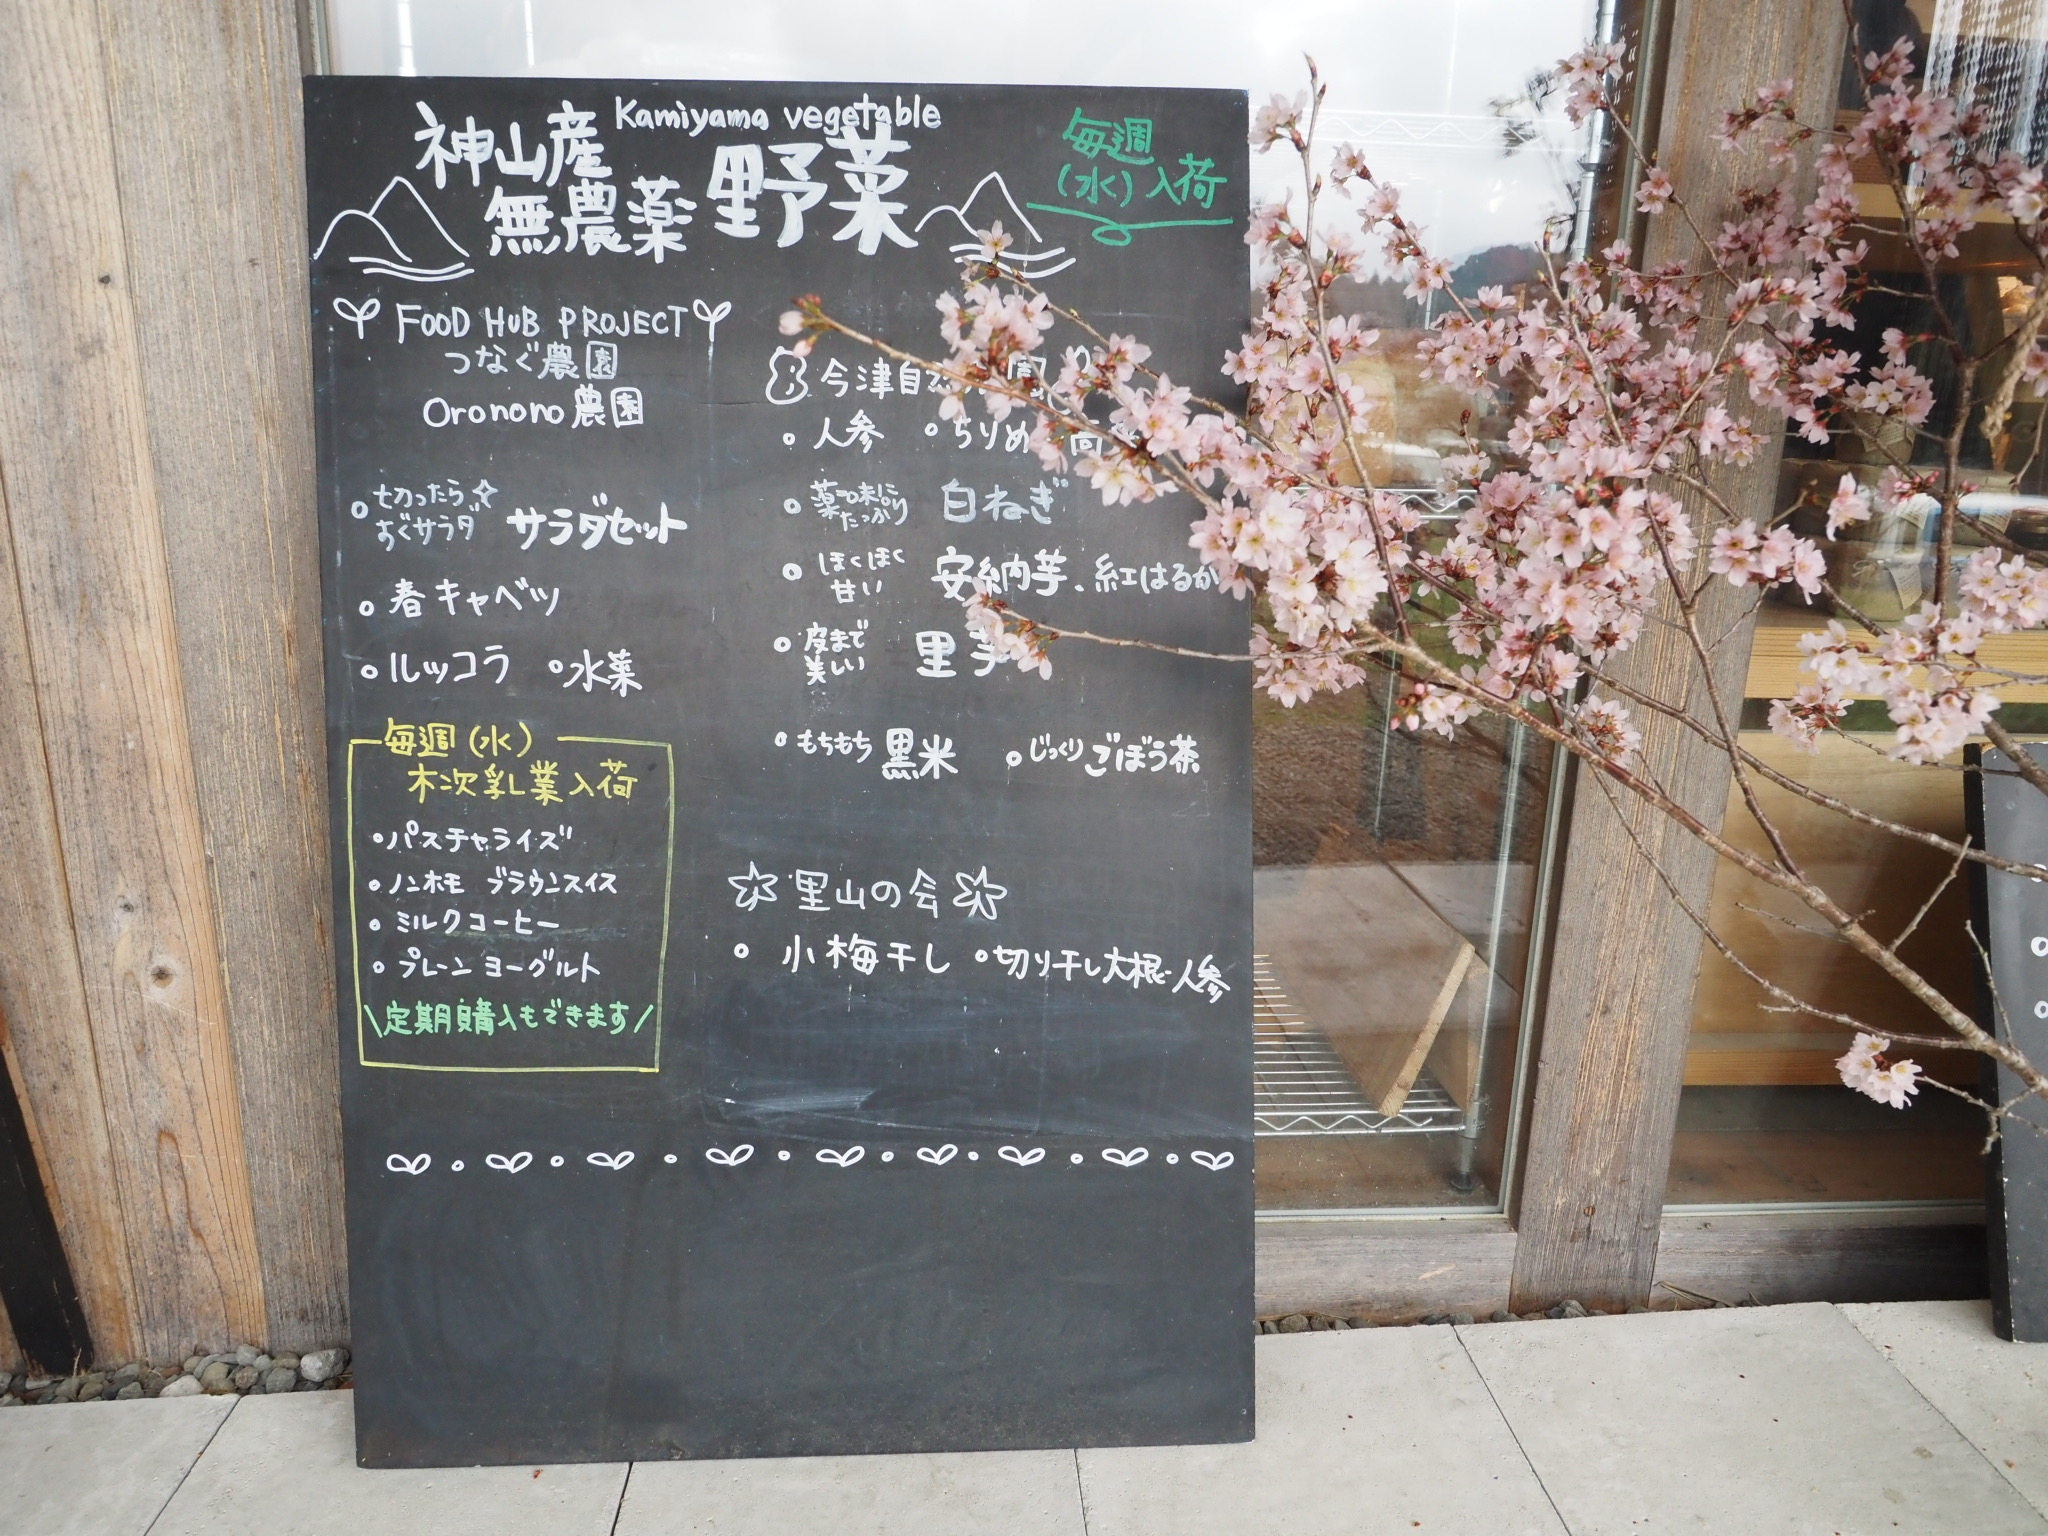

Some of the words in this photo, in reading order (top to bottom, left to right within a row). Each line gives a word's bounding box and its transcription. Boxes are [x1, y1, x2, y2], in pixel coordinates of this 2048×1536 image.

[615, 95, 770, 138] Kamiyama
[783, 92, 942, 136] vegetable
[414, 100, 614, 190] 神山産
[1062, 106, 1155, 166] 毎週
[483, 174, 698, 265] 無農薬
[558, 305, 689, 340] PROJECT
[444, 340, 618, 381] つなぐ農園
[813, 409, 885, 454] 人参
[940, 476, 1069, 525] 白ねぎ
[506, 492, 688, 551] サラダセット
[818, 547, 906, 576] ほくほく
[830, 578, 883, 604] 甘い
[803, 618, 869, 655] 皮まで
[390, 644, 510, 685] ルッコラ
[562, 648, 643, 698] 水菜
[803, 654, 866, 686] 美しい
[386, 819, 573, 853] パスチャライズ
[388, 869, 465, 895] ノンホモ
[487, 865, 618, 897] ブラウンスイス
[795, 867, 939, 919] 里山の会
[396, 908, 560, 935] ミルクコーヒー
[398, 946, 473, 979] プレーン
[484, 947, 601, 983] ヨーグルト
